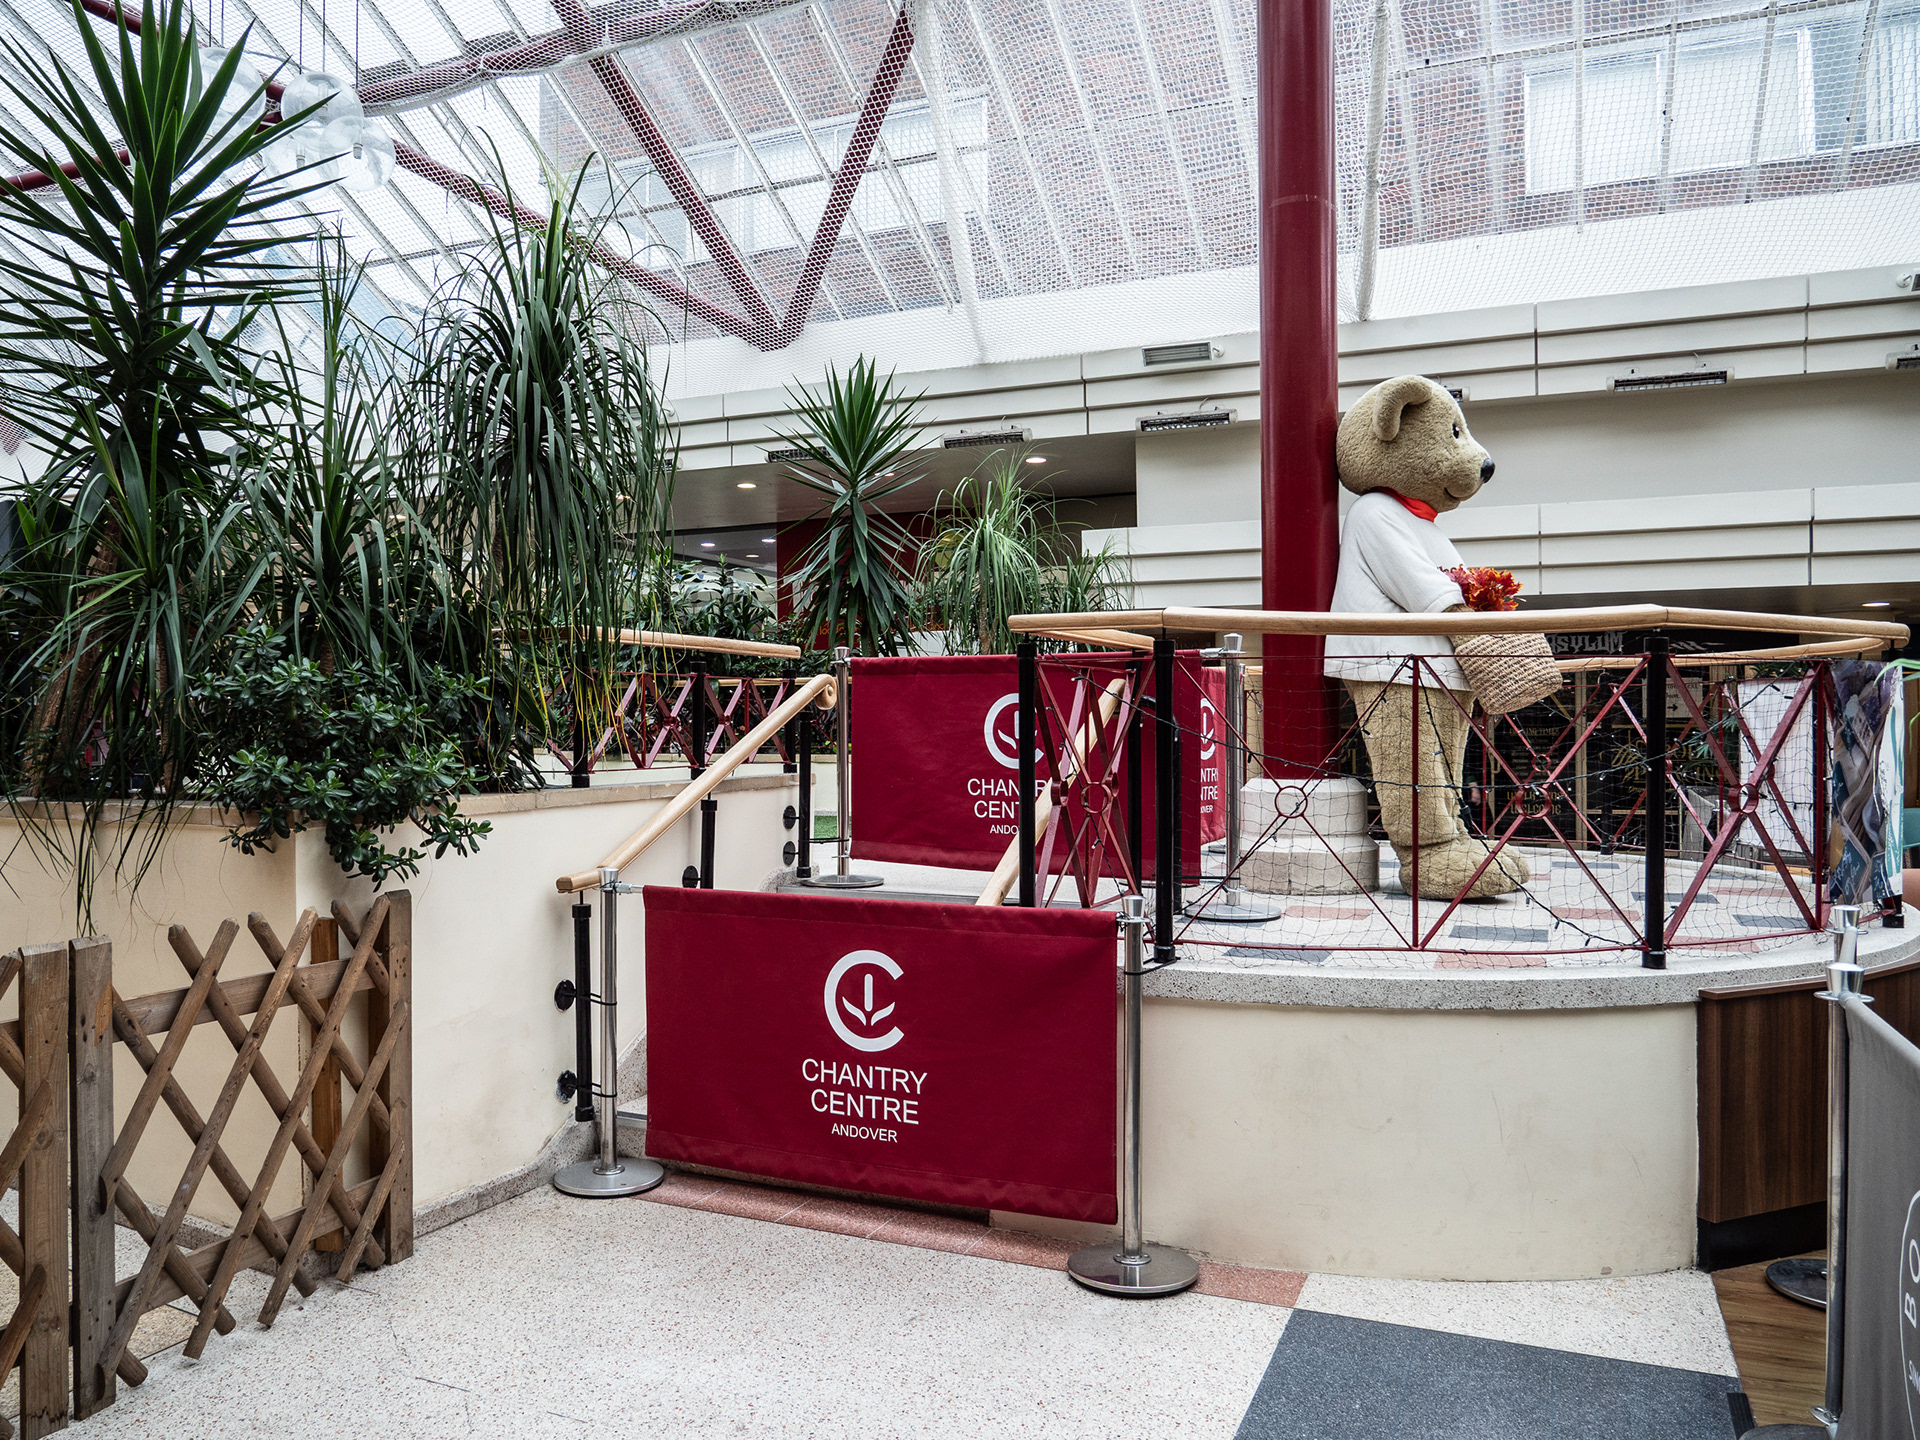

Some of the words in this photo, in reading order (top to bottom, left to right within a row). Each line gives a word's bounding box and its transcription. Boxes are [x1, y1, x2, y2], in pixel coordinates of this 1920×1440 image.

[967, 777, 1047, 797] CHANR
[973, 799, 1020, 819] CEN
[989, 824, 1020, 835] ANDO
[802, 1058, 928, 1095] CHANTRY
[810, 1088, 920, 1125] CENTRE
[831, 1122, 898, 1143] ANDOVER
